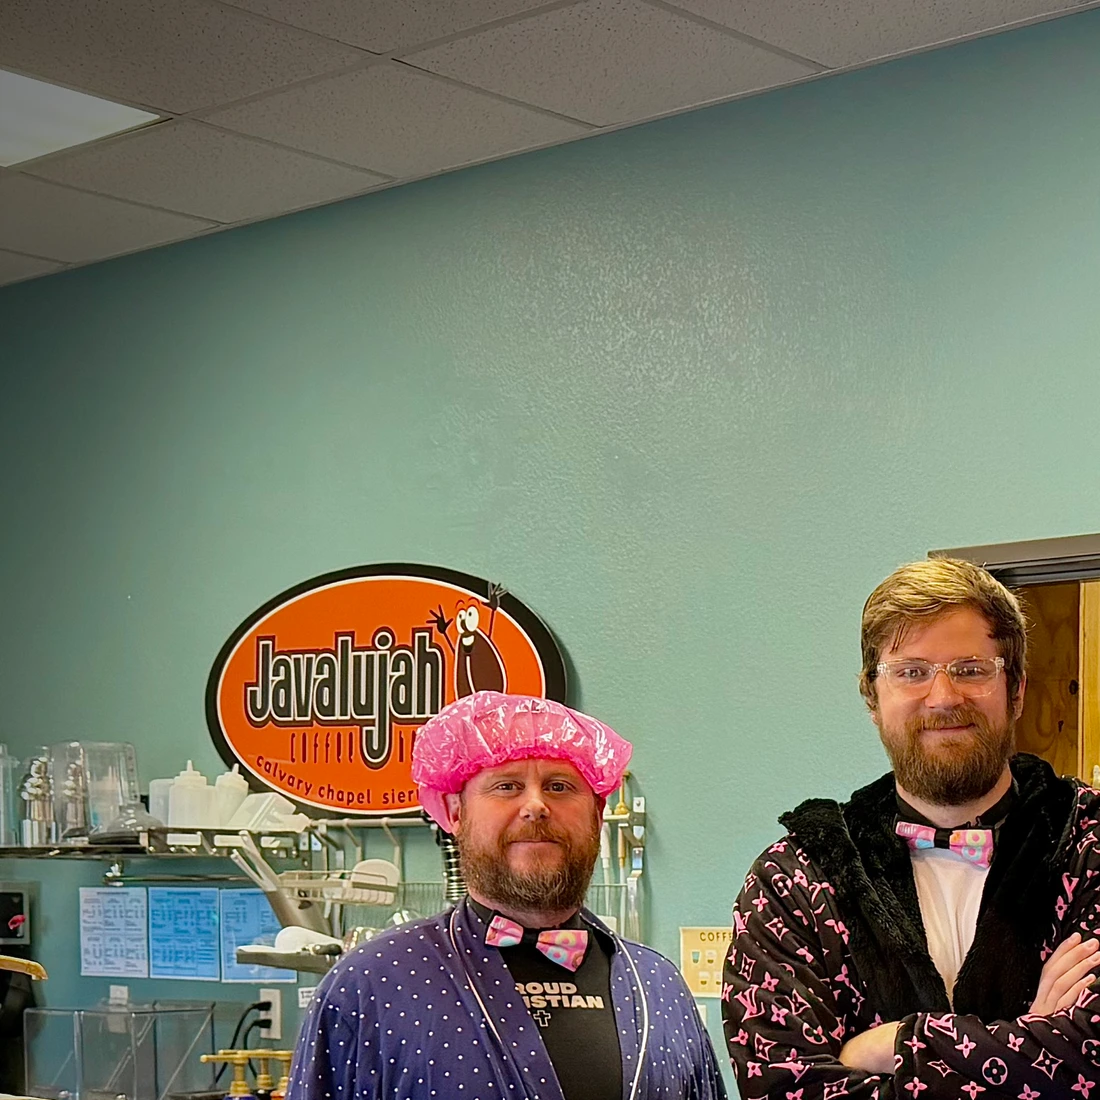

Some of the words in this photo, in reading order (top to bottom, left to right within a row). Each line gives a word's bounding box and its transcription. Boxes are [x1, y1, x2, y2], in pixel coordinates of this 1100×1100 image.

[244, 627, 446, 769] Javalujah
[256, 755, 313, 795] calvary
[318, 784, 371, 806] chapel
